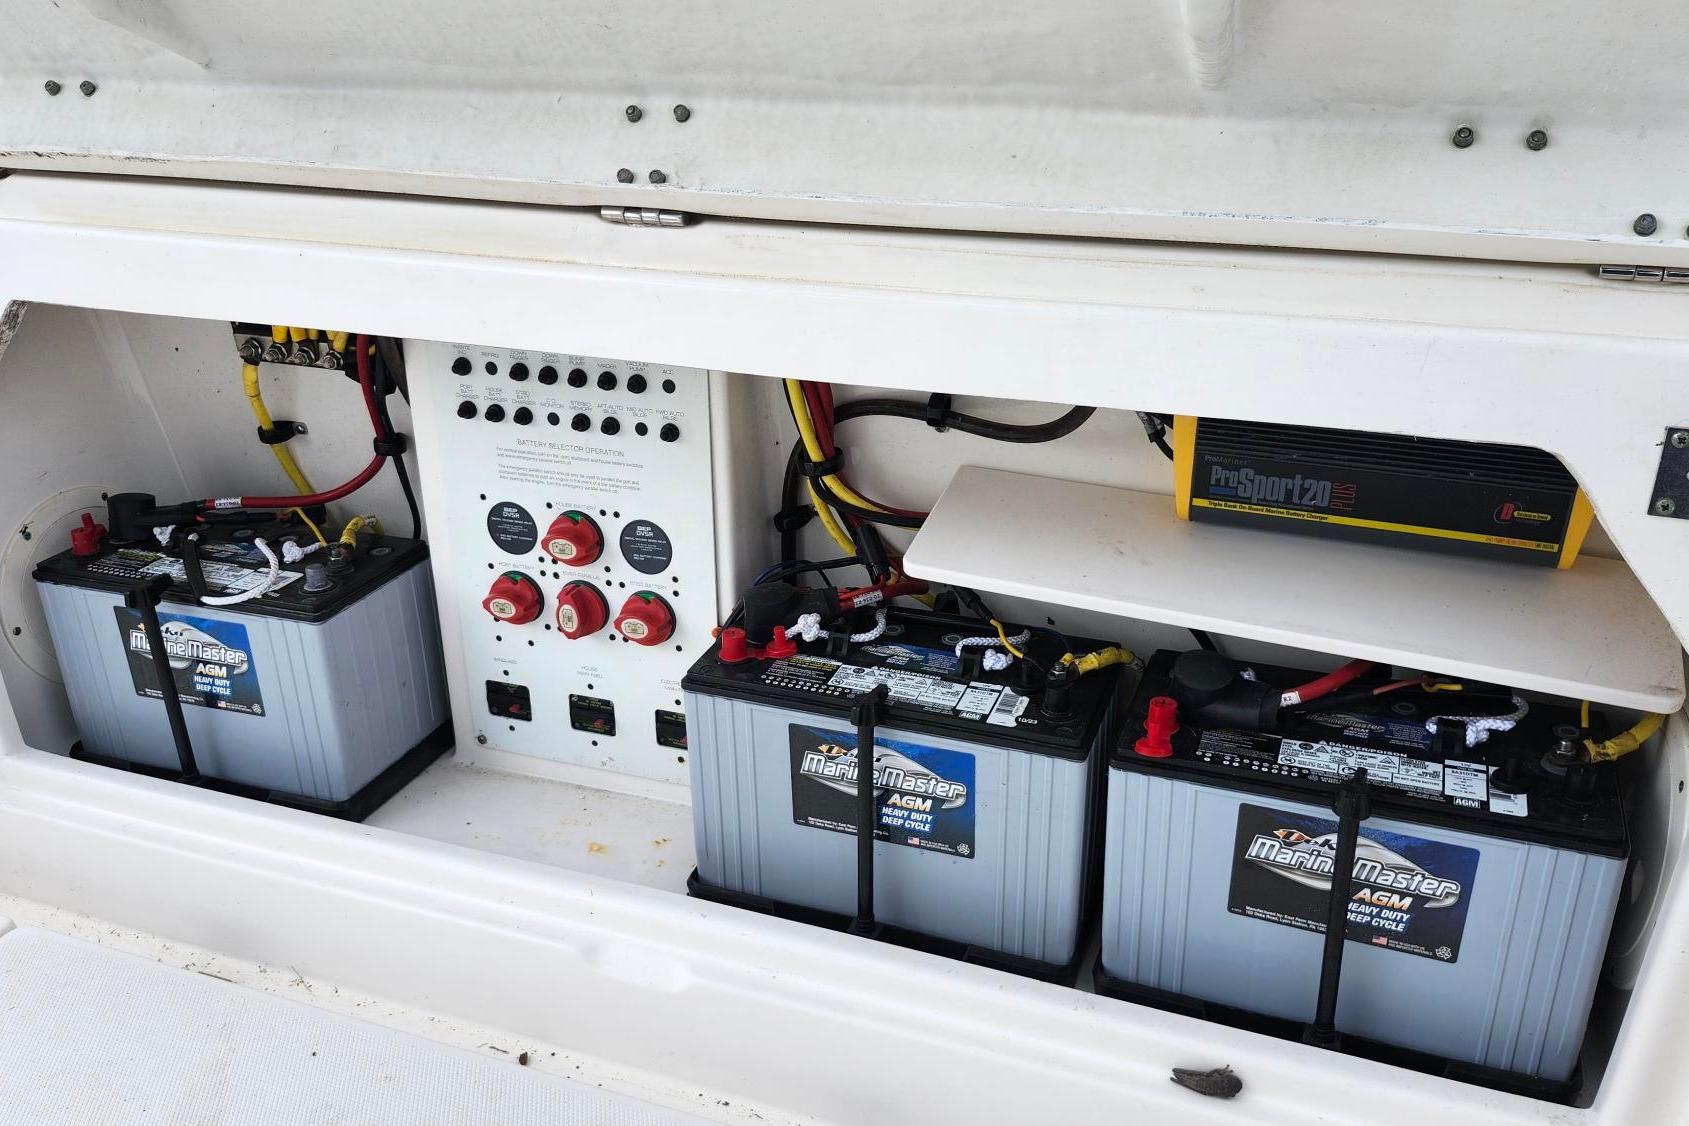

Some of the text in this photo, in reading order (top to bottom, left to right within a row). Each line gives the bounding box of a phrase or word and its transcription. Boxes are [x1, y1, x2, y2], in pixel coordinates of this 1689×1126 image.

[517, 439, 624, 457] BATTERY SELECTOR OPERATION
[1208, 500, 1222, 508] Triple
[1286, 510, 1306, 518] Battery
[1306, 513, 1328, 521] Charger
[188, 640, 247, 666] Master
[196, 662, 228, 678] AGM
[880, 666, 942, 680] DANGER/POISON
[194, 676, 230, 687] HEAVY DUTY
[196, 684, 232, 695] DEEP CYCLE
[1329, 742, 1408, 758] DANGER/POISON
[882, 766, 966, 799] Master
[888, 793, 932, 812] AGM
[1456, 798, 1478, 808] AGM
[882, 806, 933, 822] HEAVY DUTY
[882, 815, 931, 832] DEEP CYCLE
[1248, 836, 1459, 898] Marin Master
[1352, 887, 1413, 910] AGM
[1381, 908, 1410, 922] DUTY
[1372, 918, 1406, 931] CYCLE
